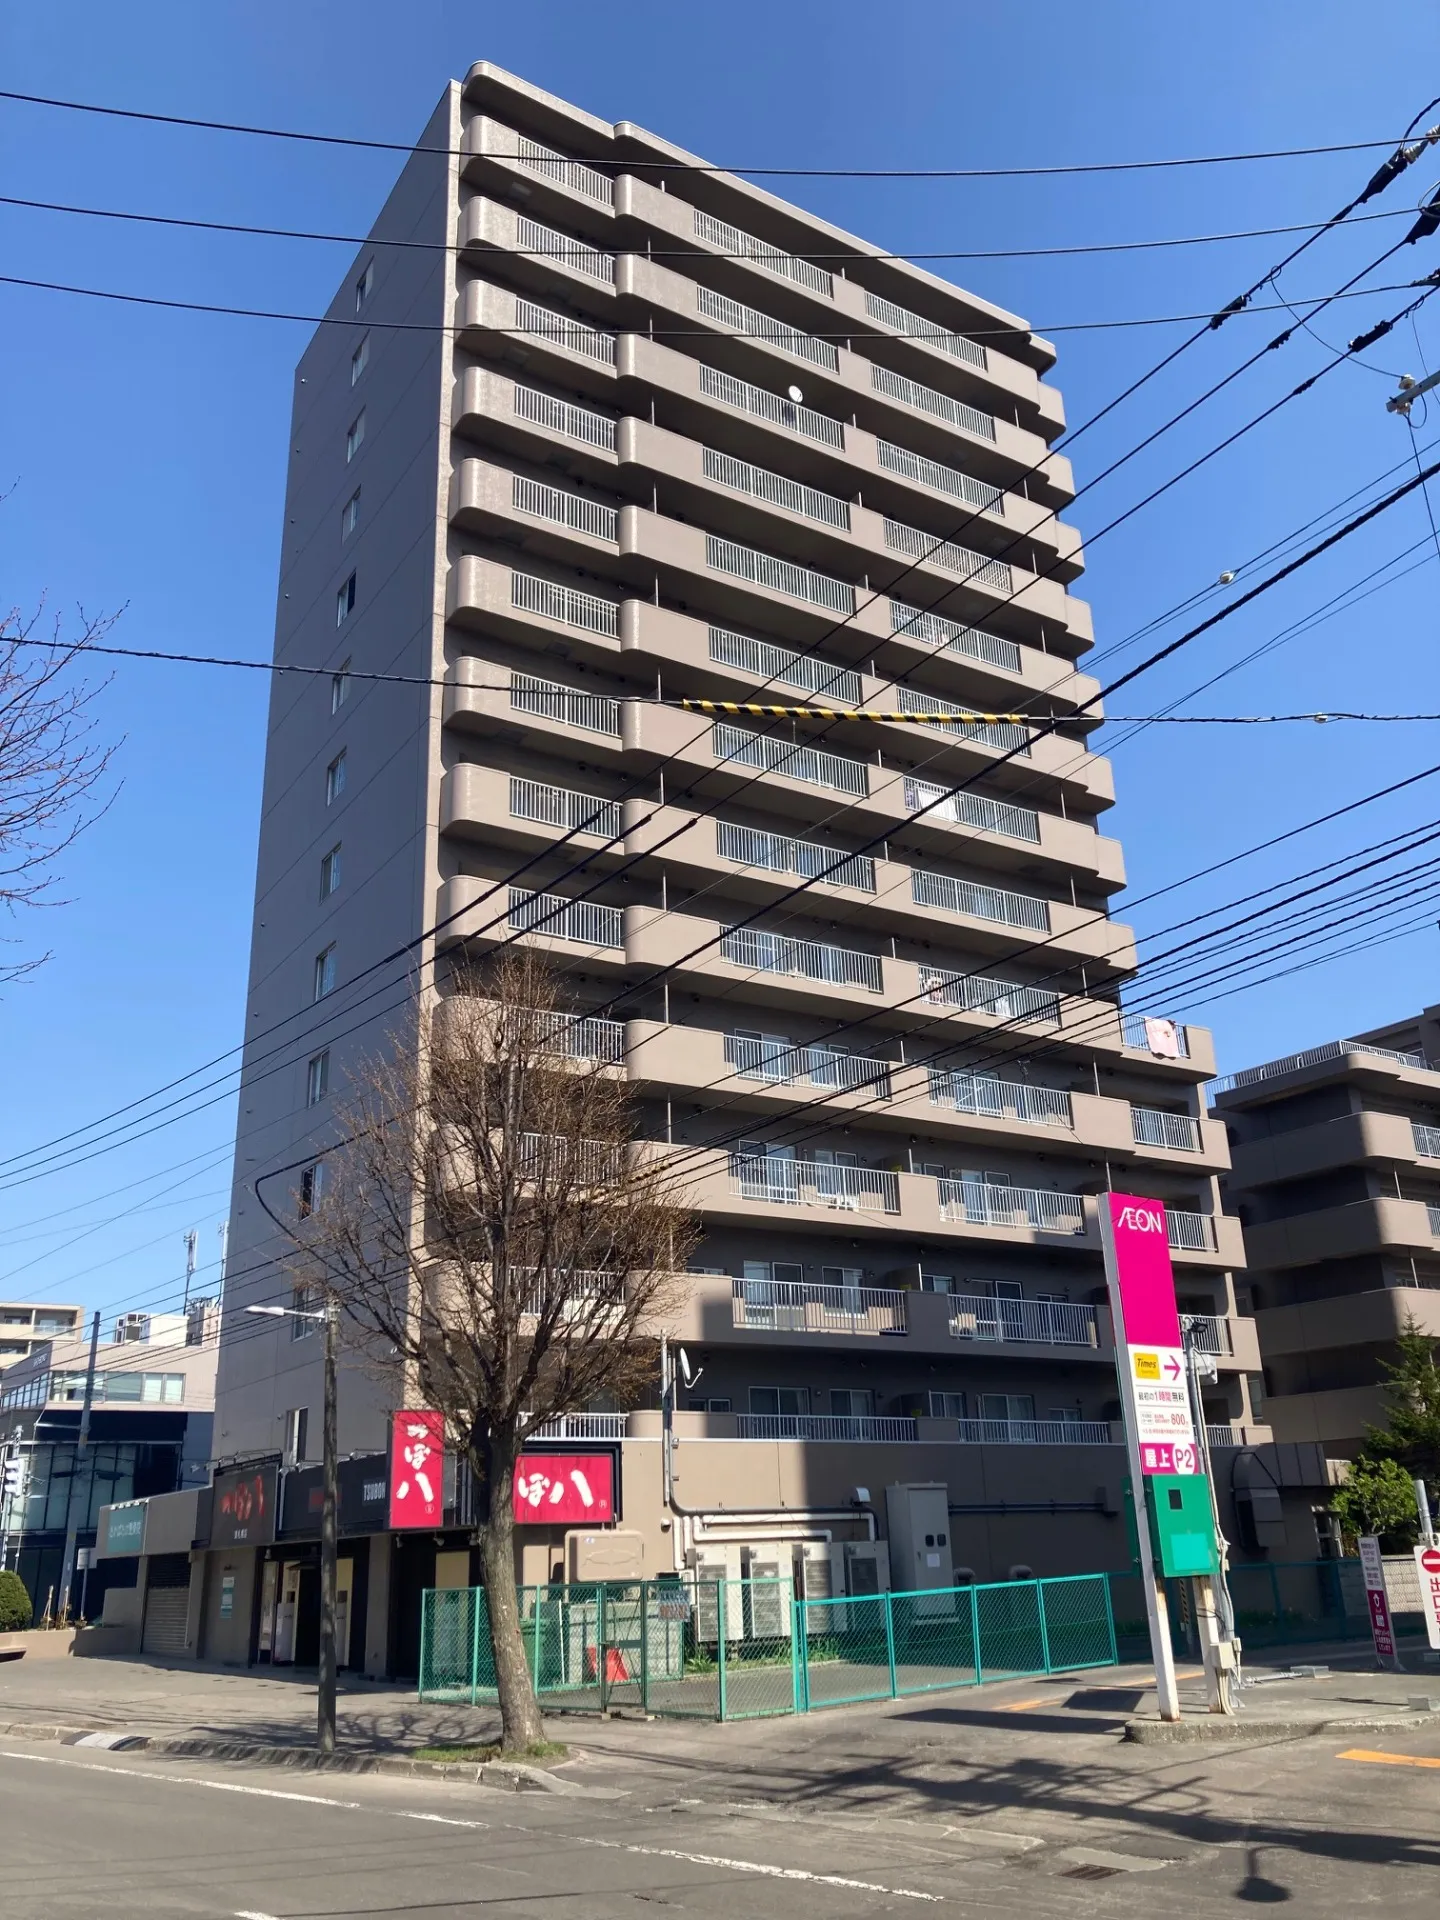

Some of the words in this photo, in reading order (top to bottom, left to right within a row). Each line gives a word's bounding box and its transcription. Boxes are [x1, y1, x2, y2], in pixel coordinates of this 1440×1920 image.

[1136, 1358, 1157, 1369] Times
[396, 1423, 435, 1503] つぼ八
[1144, 1448, 1171, 1468] 屋上
[1175, 1448, 1193, 1468] P2
